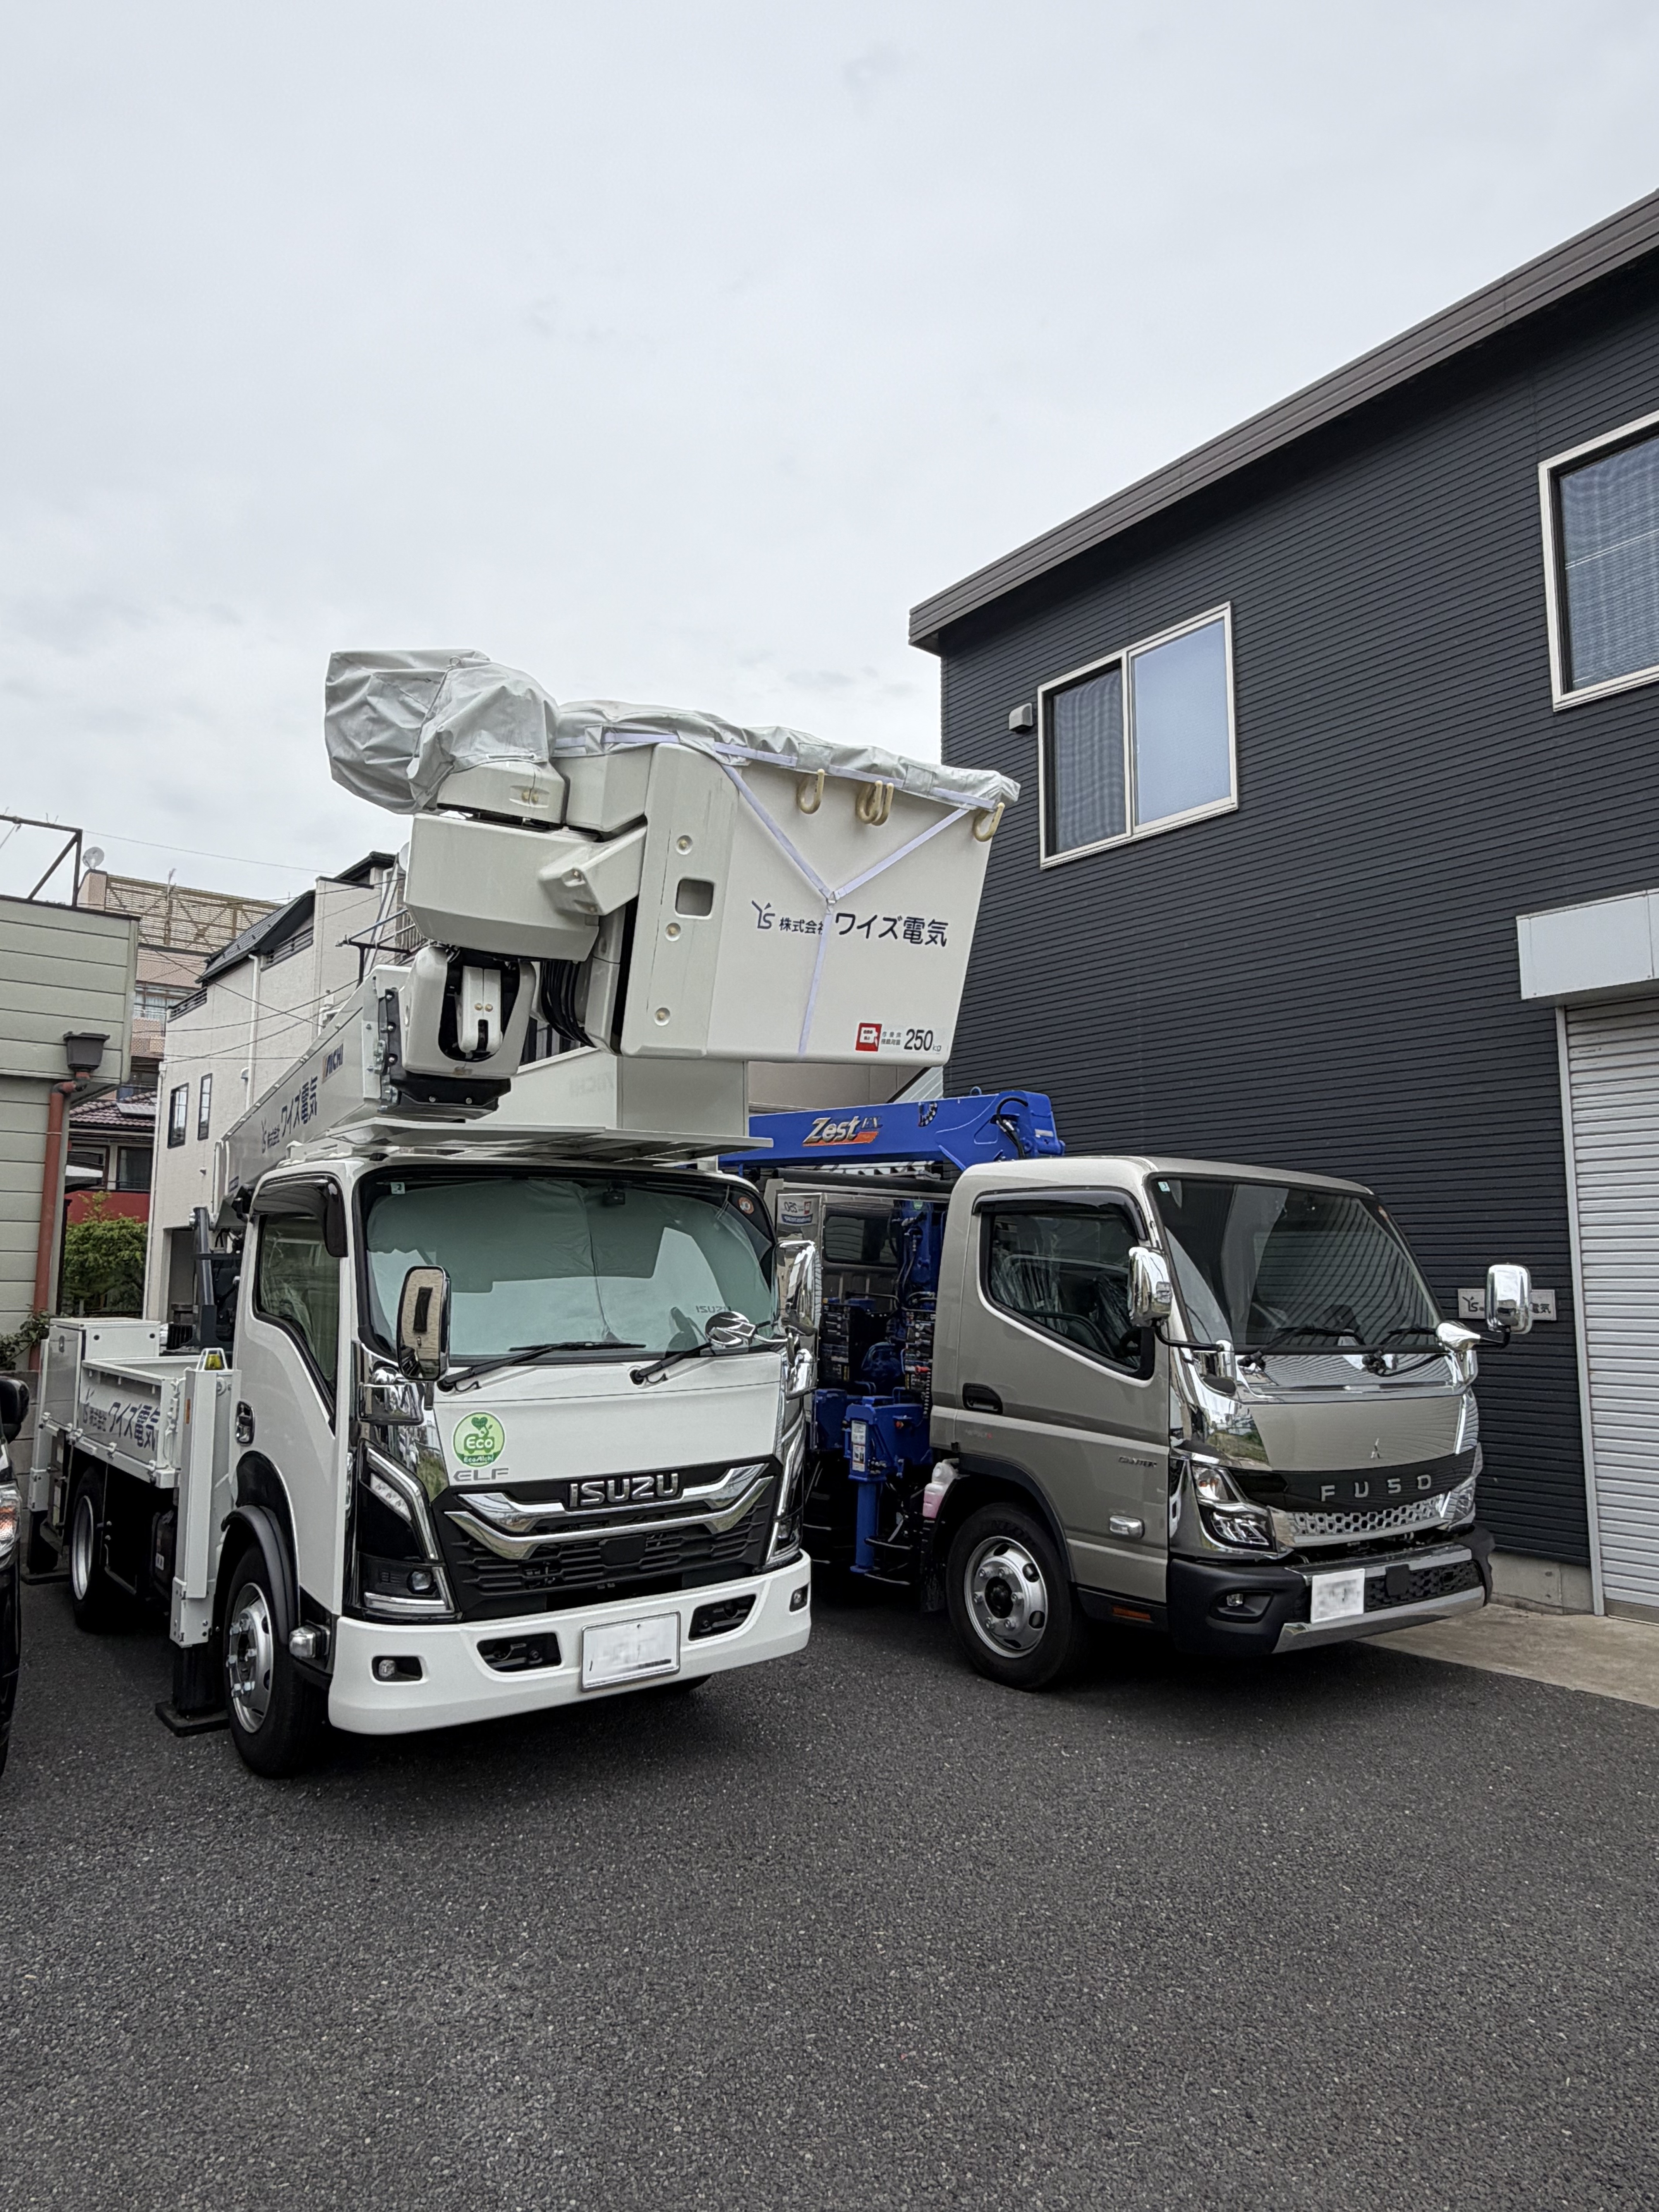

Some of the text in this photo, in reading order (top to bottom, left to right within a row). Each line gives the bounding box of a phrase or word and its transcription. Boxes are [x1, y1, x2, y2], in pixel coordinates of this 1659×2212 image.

[835, 912, 948, 947] ワイズ電気
[904, 1029, 933, 1051] 250
[325, 1043, 343, 1078] AICHI
[802, 1116, 860, 1143] Zest
[109, 1401, 161, 1452] ワイズ電気
[466, 1436, 493, 1449] Eco
[453, 1468, 509, 1482] ELF
[1321, 1474, 1432, 1502] FUSO
[570, 1473, 678, 1508] ISUZU
